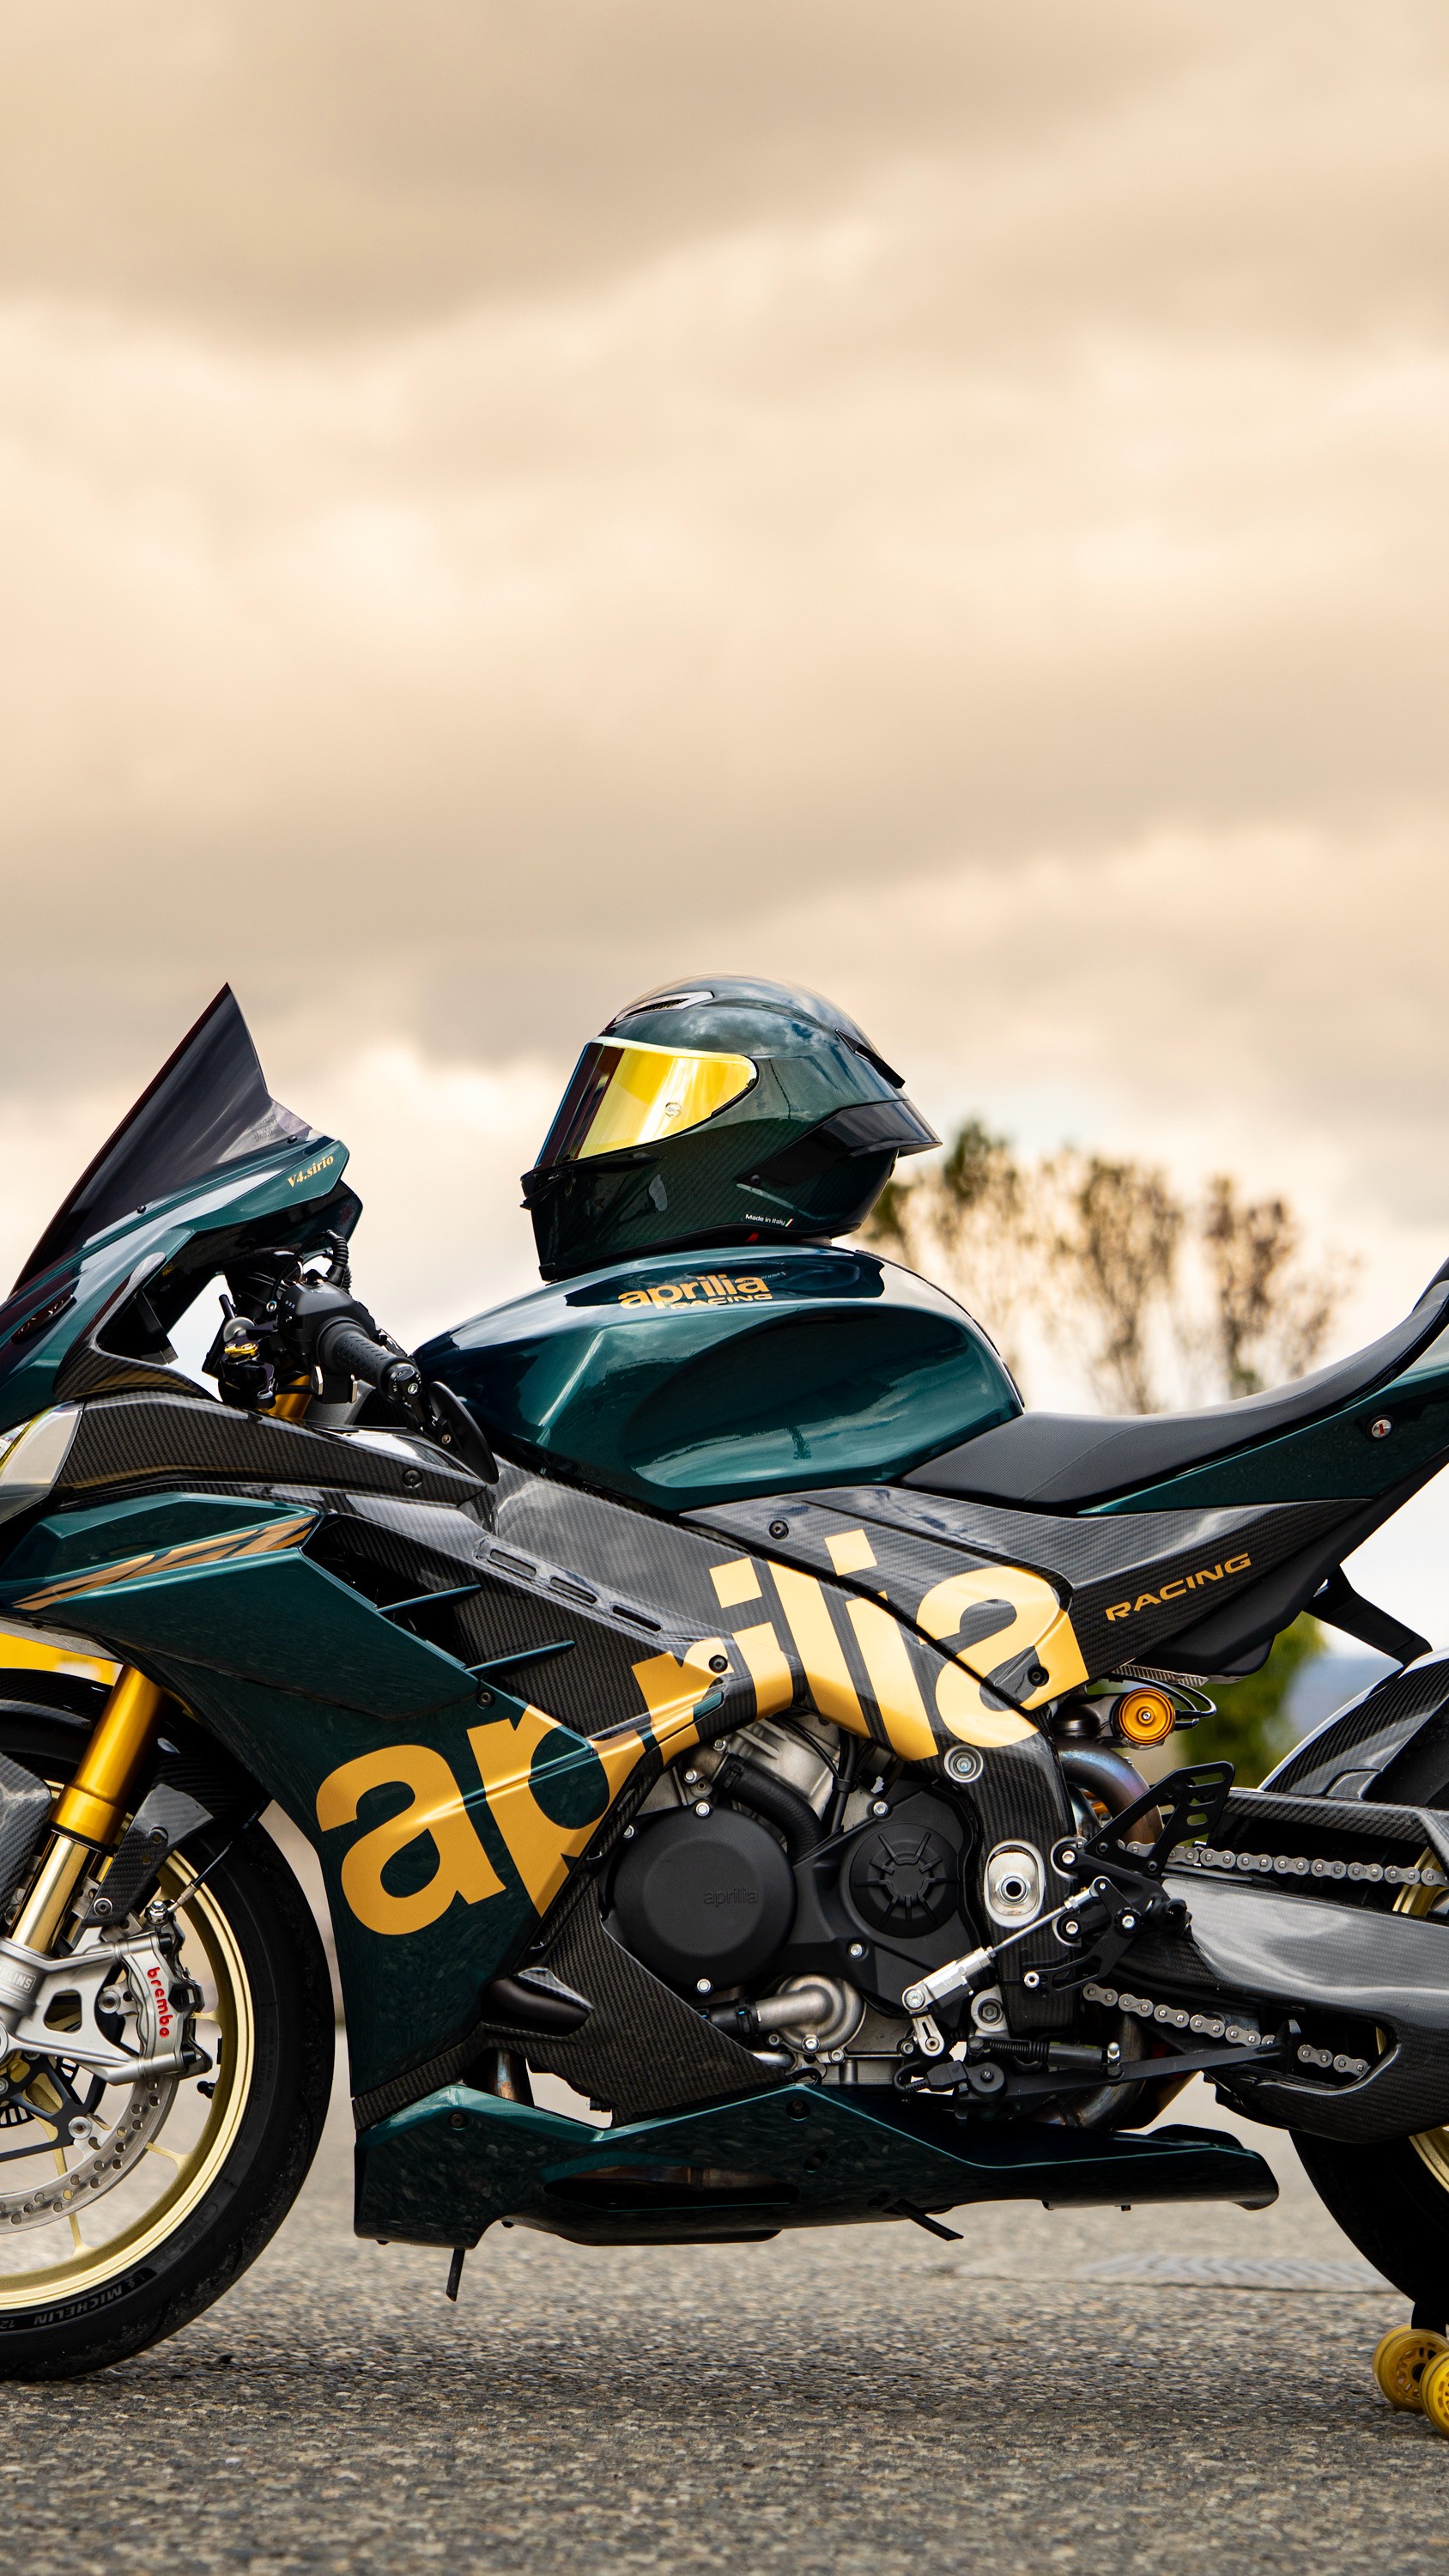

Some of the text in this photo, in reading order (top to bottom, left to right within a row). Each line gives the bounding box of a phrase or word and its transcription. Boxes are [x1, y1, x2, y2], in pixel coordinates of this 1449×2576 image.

[287, 1156, 334, 1188] V4.sirio
[745, 1213, 764, 1222] Made
[617, 1273, 769, 1309] aprilia
[670, 1293, 773, 1309] RACING
[1105, 1552, 1252, 1621] RACING
[316, 1528, 1088, 1935] aprilia
[704, 1887, 757, 1908] aprilia
[147, 1966, 174, 2038] brembo
[33, 2286, 123, 2325] MICHELIN
